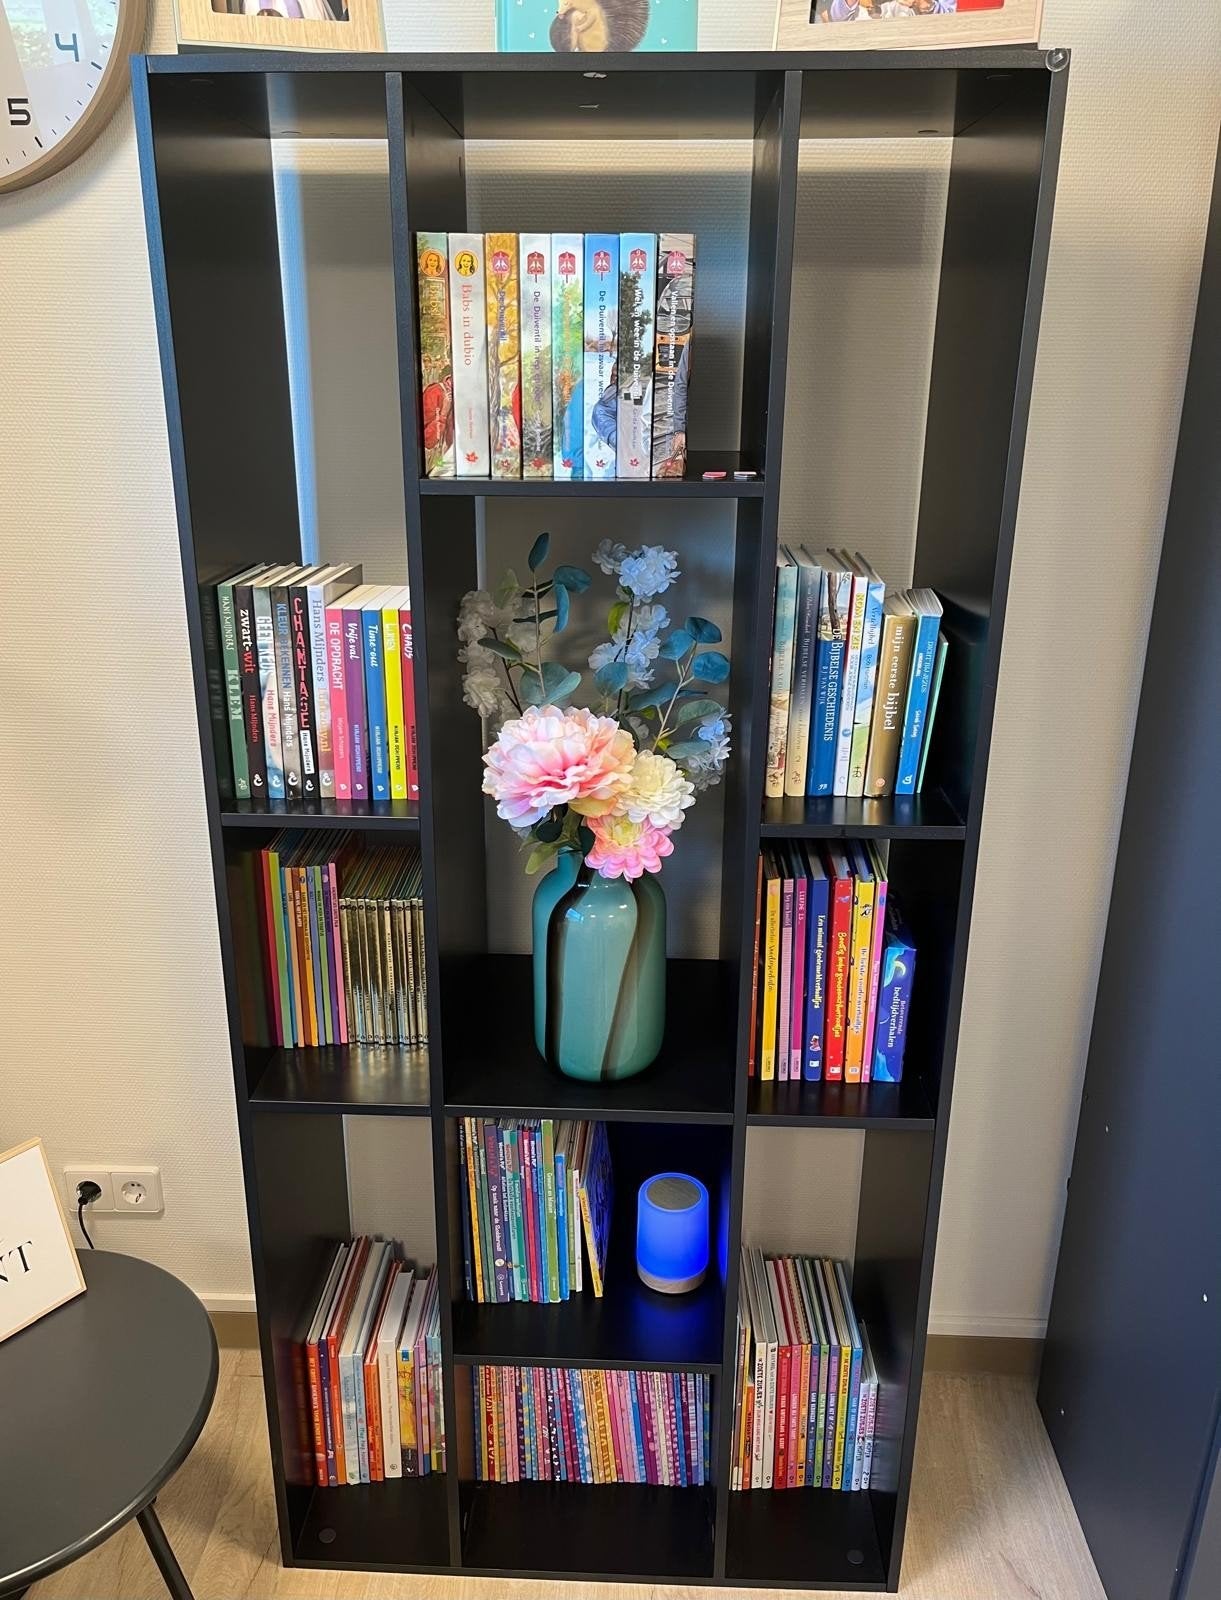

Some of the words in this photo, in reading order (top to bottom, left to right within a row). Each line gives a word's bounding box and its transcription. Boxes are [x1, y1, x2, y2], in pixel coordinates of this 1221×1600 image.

[55, 33, 80, 62] 4
[7, 98, 31, 126] 5
[462, 284, 473, 312] Babs
[499, 291, 505, 302] De
[534, 291, 540, 302] De
[600, 291, 606, 302] De
[634, 289, 642, 304] Wel
[670, 291, 678, 314] Vallen
[463, 316, 473, 326] in
[634, 308, 641, 318] en
[670, 316, 676, 326] en
[634, 320, 642, 337] wee
[463, 332, 475, 366] dubio
[534, 345, 541, 353] in
[634, 340, 641, 348] in
[634, 350, 642, 361] de
[667, 328, 676, 359] opstaan
[633, 364, 641, 399] Duiventil
[668, 370, 676, 379] de
[222, 596, 230, 615] HANS
[312, 600, 322, 628] Hans
[855, 593, 864, 617] KOM
[256, 616, 273, 643] GEEN
[277, 603, 287, 635] KLEUR
[330, 622, 340, 635] DE
[224, 616, 234, 650] MIJNDERS
[240, 609, 255, 673] zwart-wit
[346, 623, 358, 643] Vrije
[368, 625, 378, 668] Time-out
[832, 629, 841, 640] DE
[892, 626, 904, 652] mijn
[280, 639, 291, 689] BEKENNEN
[293, 597, 310, 728] CHANTAGE
[314, 631, 326, 682] Mijnders
[331, 638, 343, 690] OPDRACHT
[349, 644, 360, 660] val
[829, 642, 843, 679] BIJBELSE
[926, 641, 934, 661] DICHT
[888, 656, 899, 689] eerste
[227, 669, 242, 720] KLEM
[267, 690, 275, 710] Hans
[283, 691, 291, 711] Hans
[823, 681, 837, 741] GESCHIEDENIS
[883, 692, 900, 730] bijbel
[268, 713, 277, 747] Mijnders
[284, 714, 293, 747] Mijnders
[887, 987, 901, 1048] bedtijdverhalen
